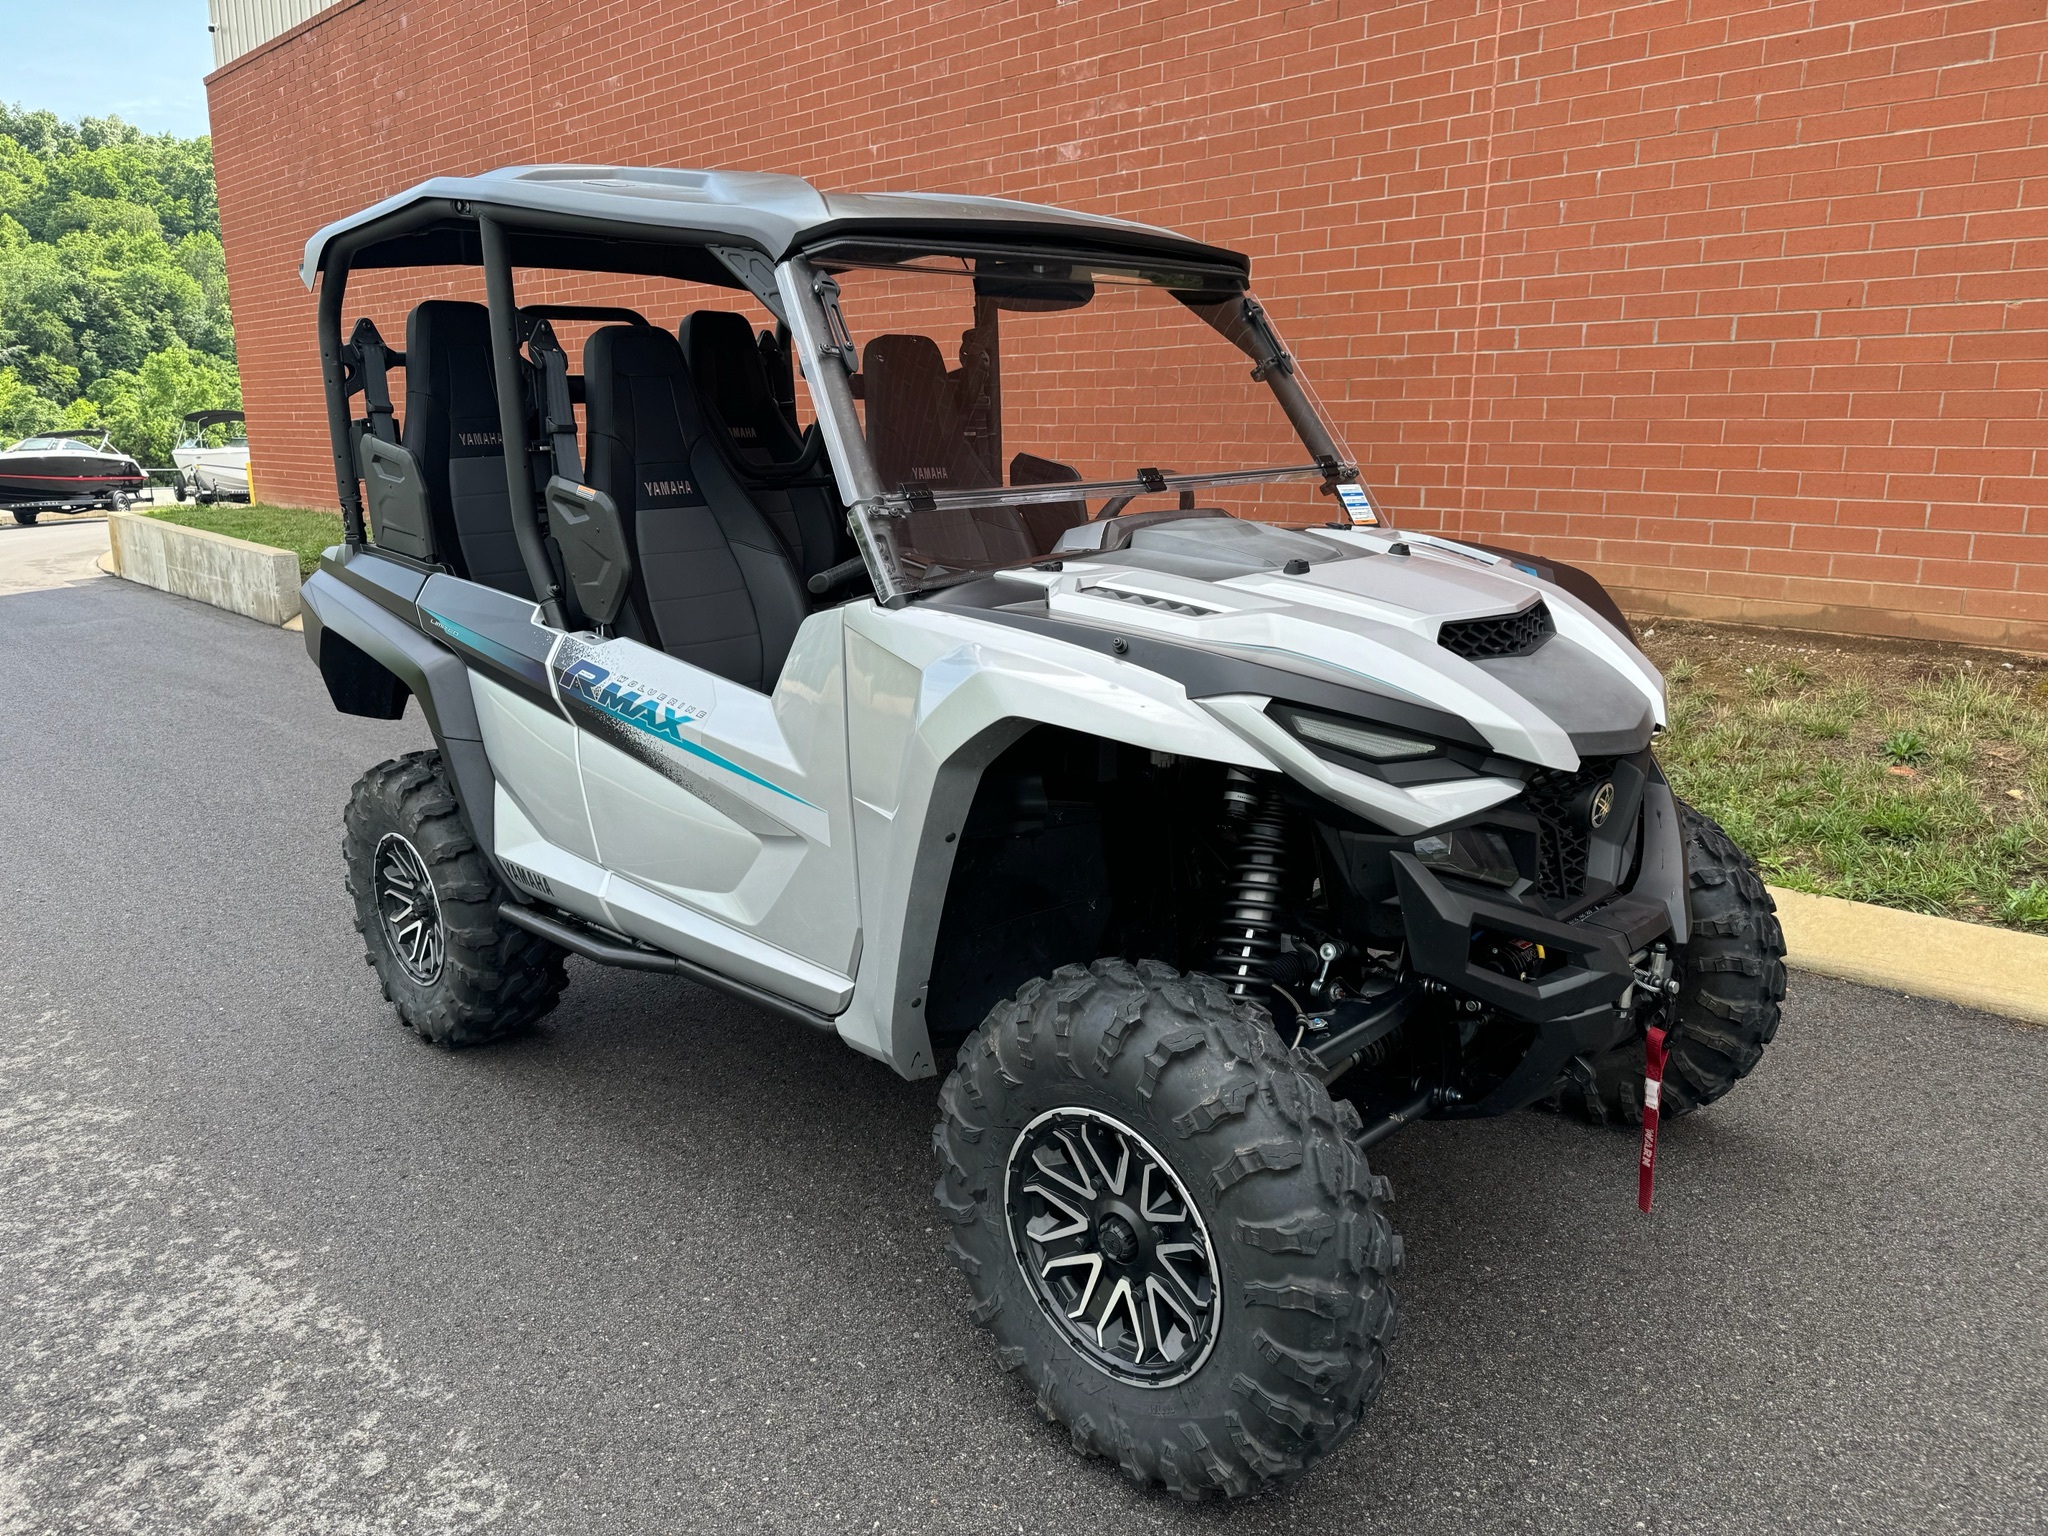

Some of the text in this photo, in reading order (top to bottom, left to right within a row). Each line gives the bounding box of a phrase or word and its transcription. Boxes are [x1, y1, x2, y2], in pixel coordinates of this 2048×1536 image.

[458, 432, 503, 446] YAMAHA
[911, 467, 948, 480] YAMAHA
[643, 480, 693, 497] YAMAHA
[558, 658, 696, 743] RMAX
[501, 859, 555, 898] YAMAHA
[1641, 1128, 1655, 1168] WARN
